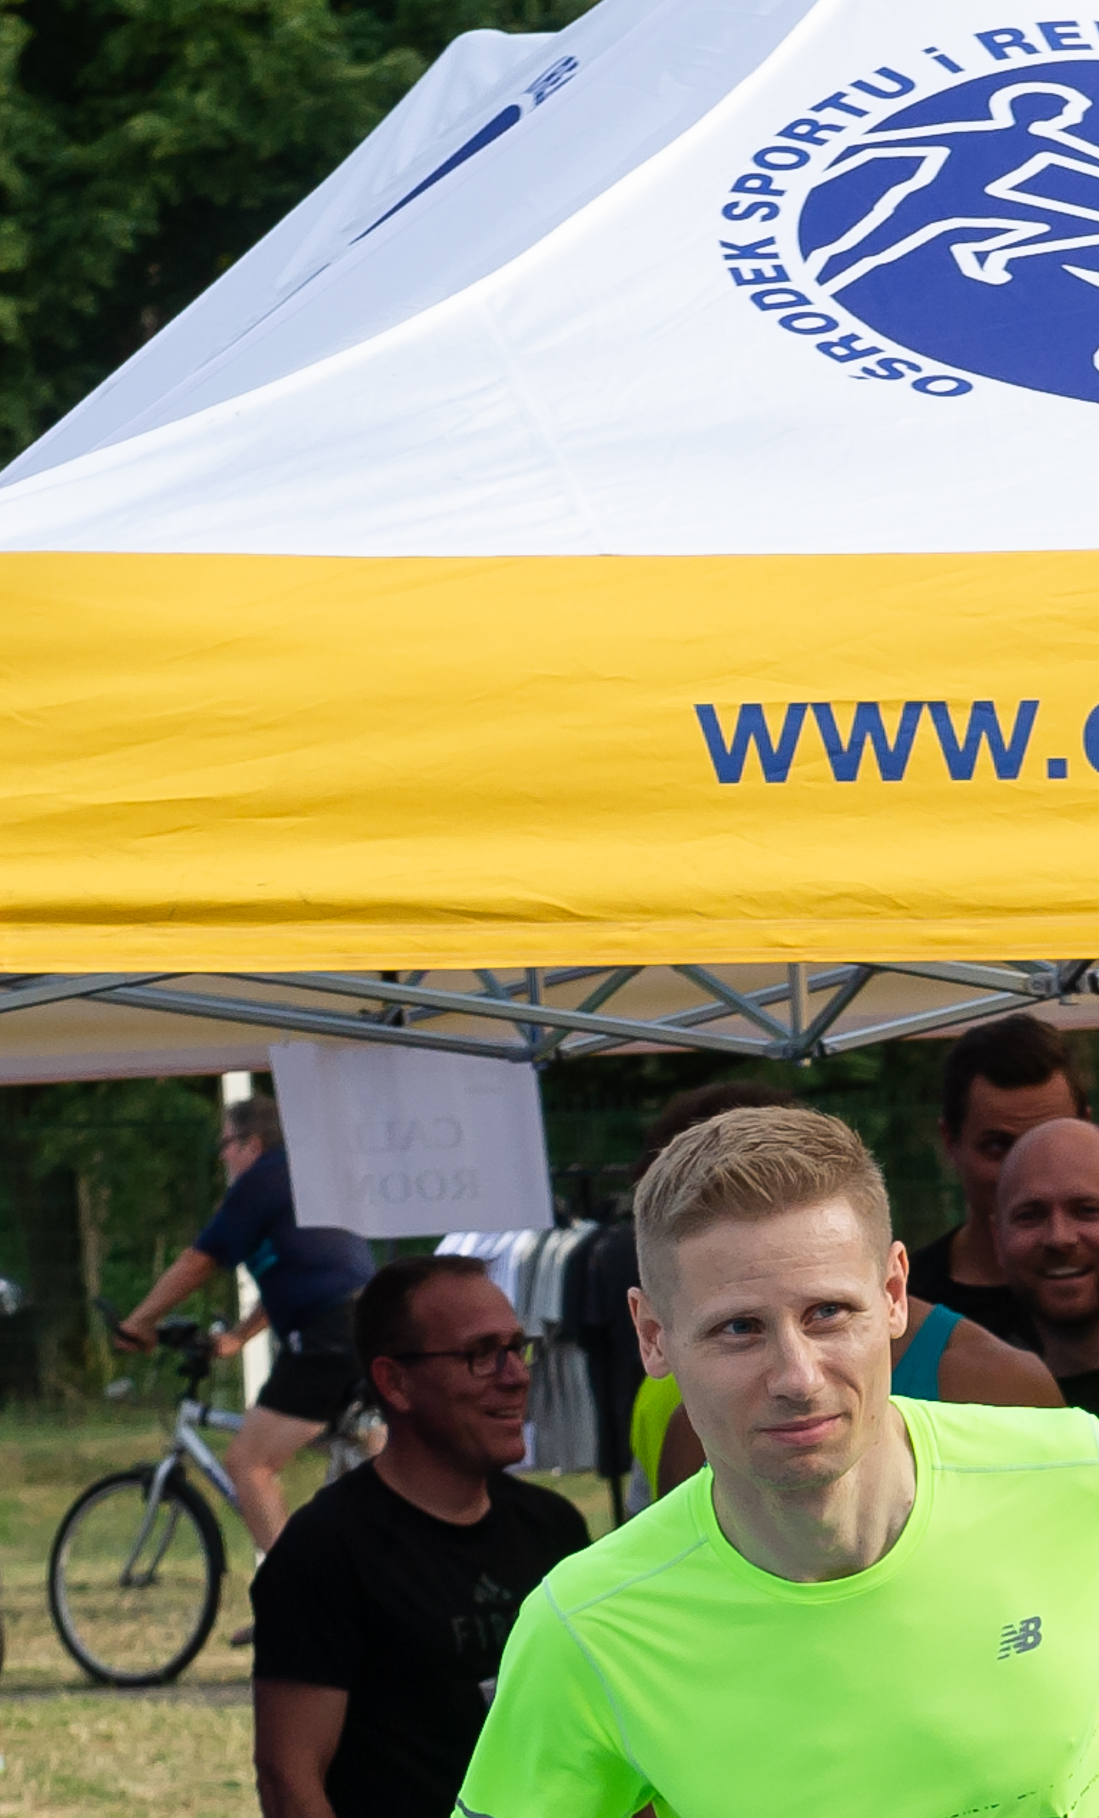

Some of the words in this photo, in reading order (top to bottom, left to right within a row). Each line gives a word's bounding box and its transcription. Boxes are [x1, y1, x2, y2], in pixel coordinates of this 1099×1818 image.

[923, 46, 967, 75] i
[721, 66, 917, 223] SPORTU
[719, 236, 973, 398] OŚRODEK
